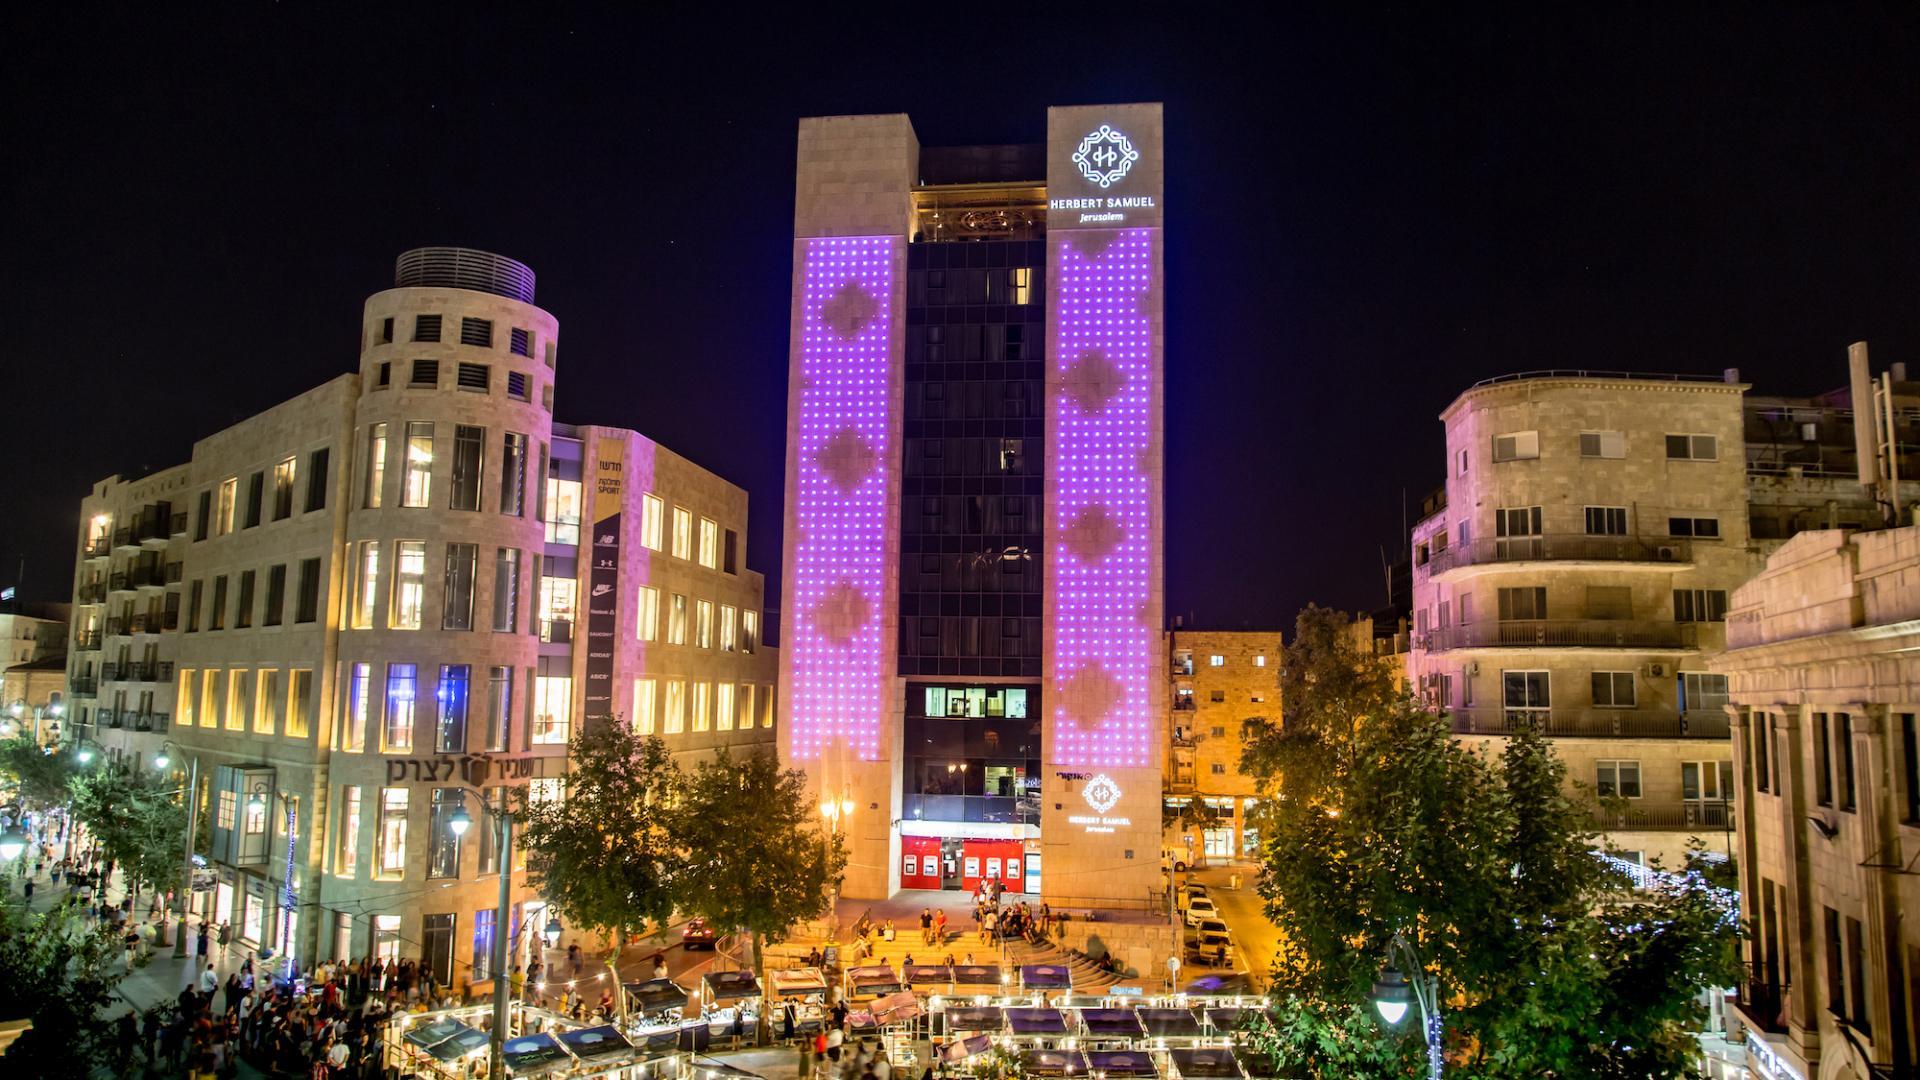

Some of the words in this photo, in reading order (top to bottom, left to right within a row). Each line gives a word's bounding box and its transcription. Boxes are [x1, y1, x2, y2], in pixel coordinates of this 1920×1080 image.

[1050, 199, 1103, 209] HERBERT
[1107, 197, 1155, 207] SAMUEL
[1080, 212, 1123, 223] Jerusalem
[598, 486, 620, 494] SPORT
[386, 755, 455, 786] לצרכן
